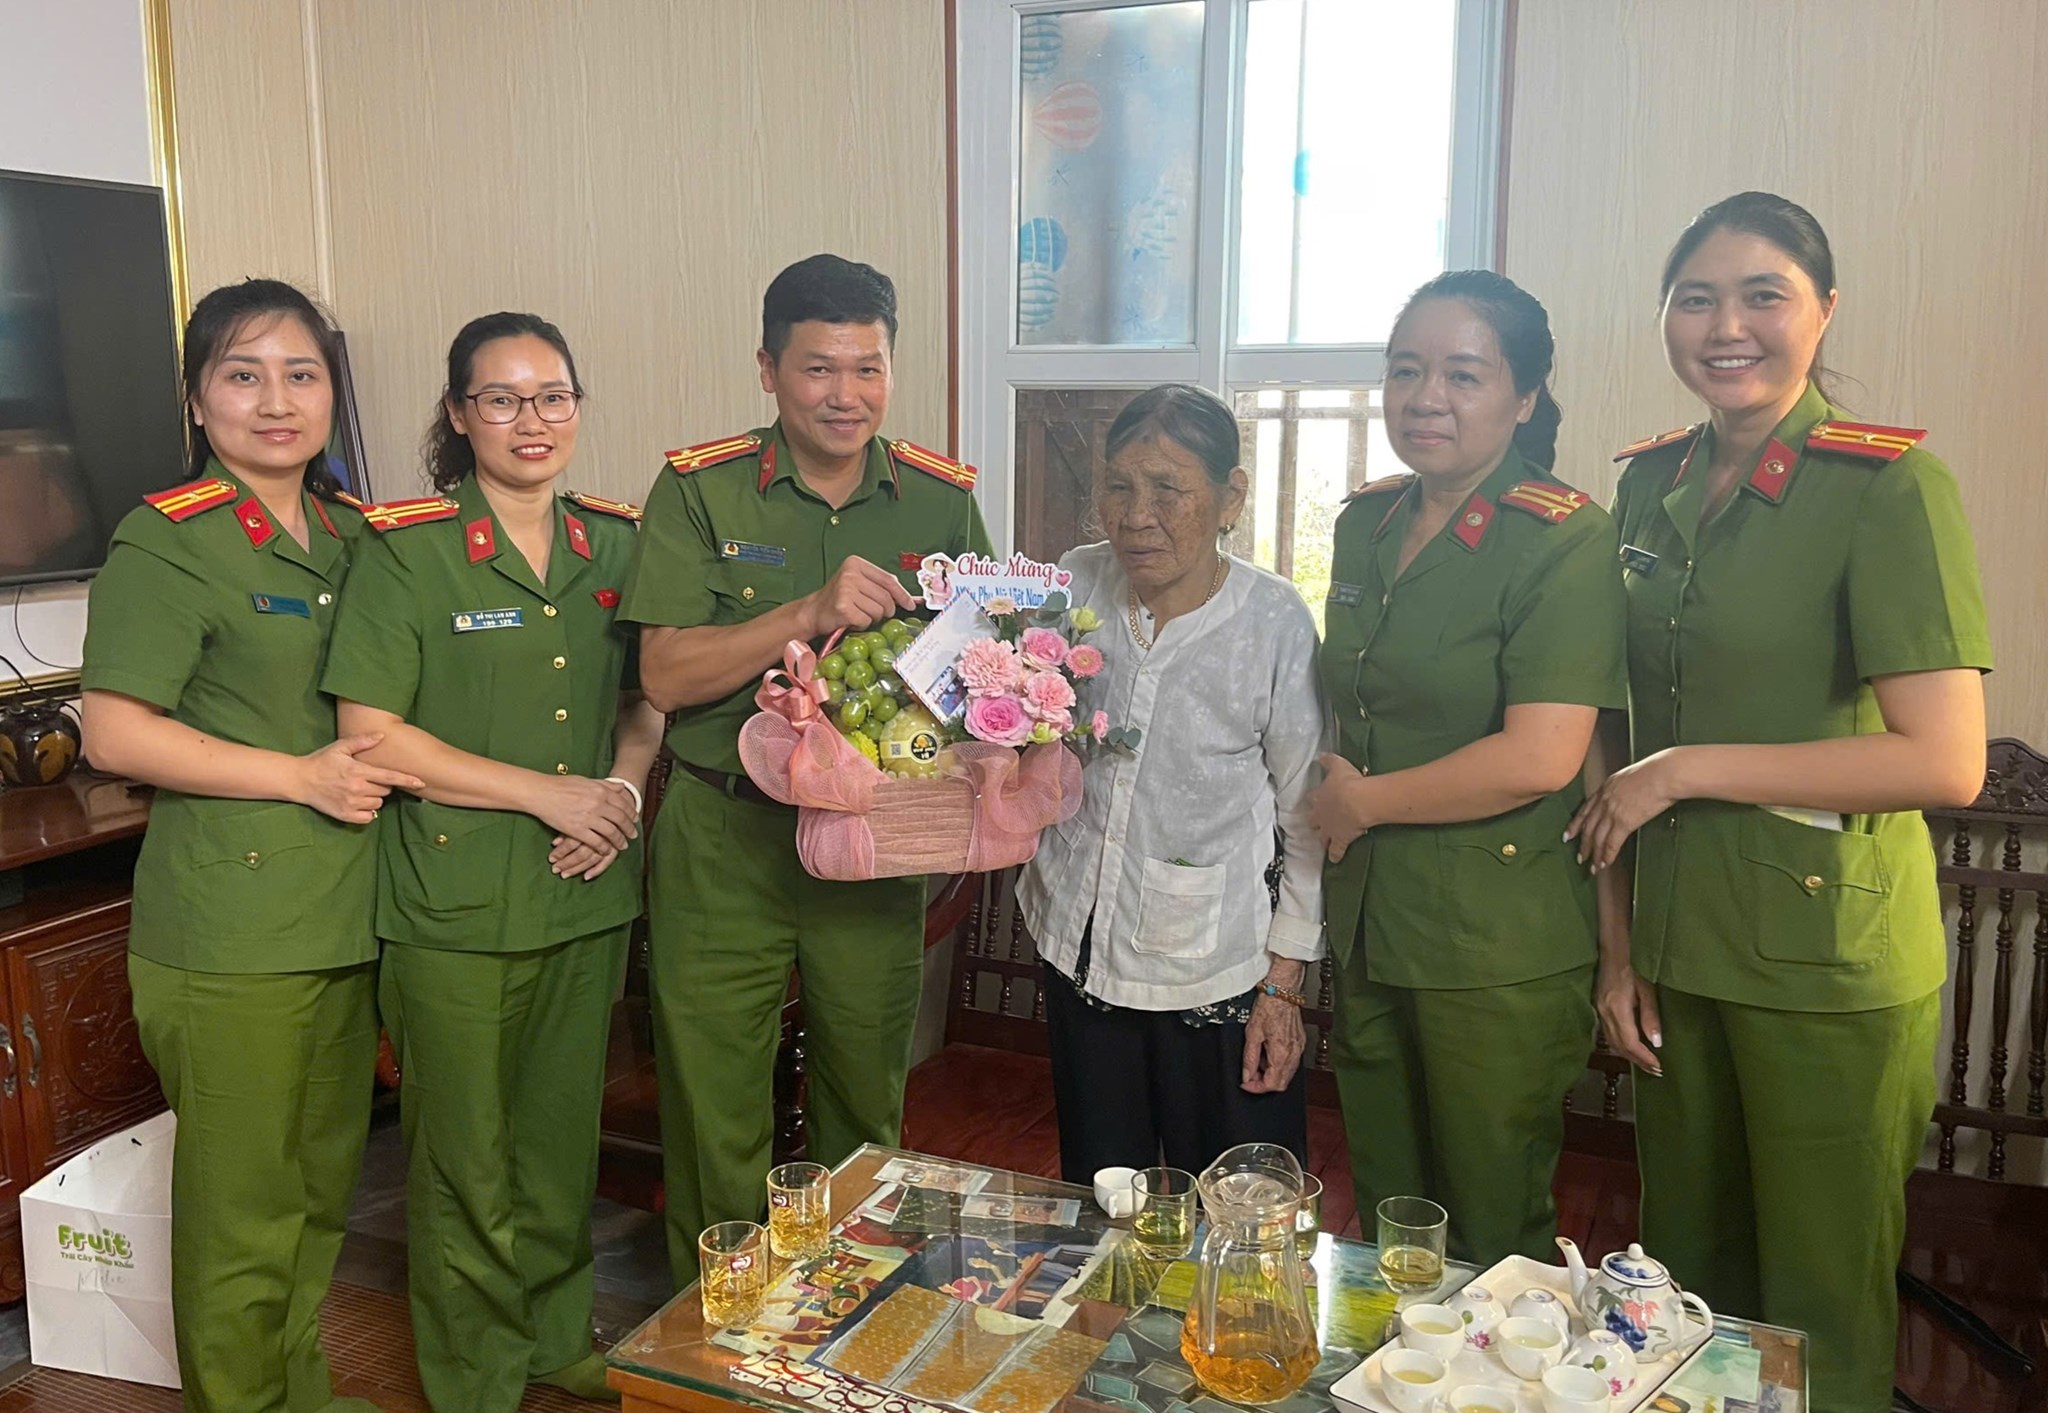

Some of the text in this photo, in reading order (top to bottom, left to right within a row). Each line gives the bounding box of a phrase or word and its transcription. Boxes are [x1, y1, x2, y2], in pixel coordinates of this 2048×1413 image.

[958, 556, 1054, 588] Chúc Mừng
[1026, 588, 1045, 605] Nam
[58, 1224, 133, 1259] Fruit
